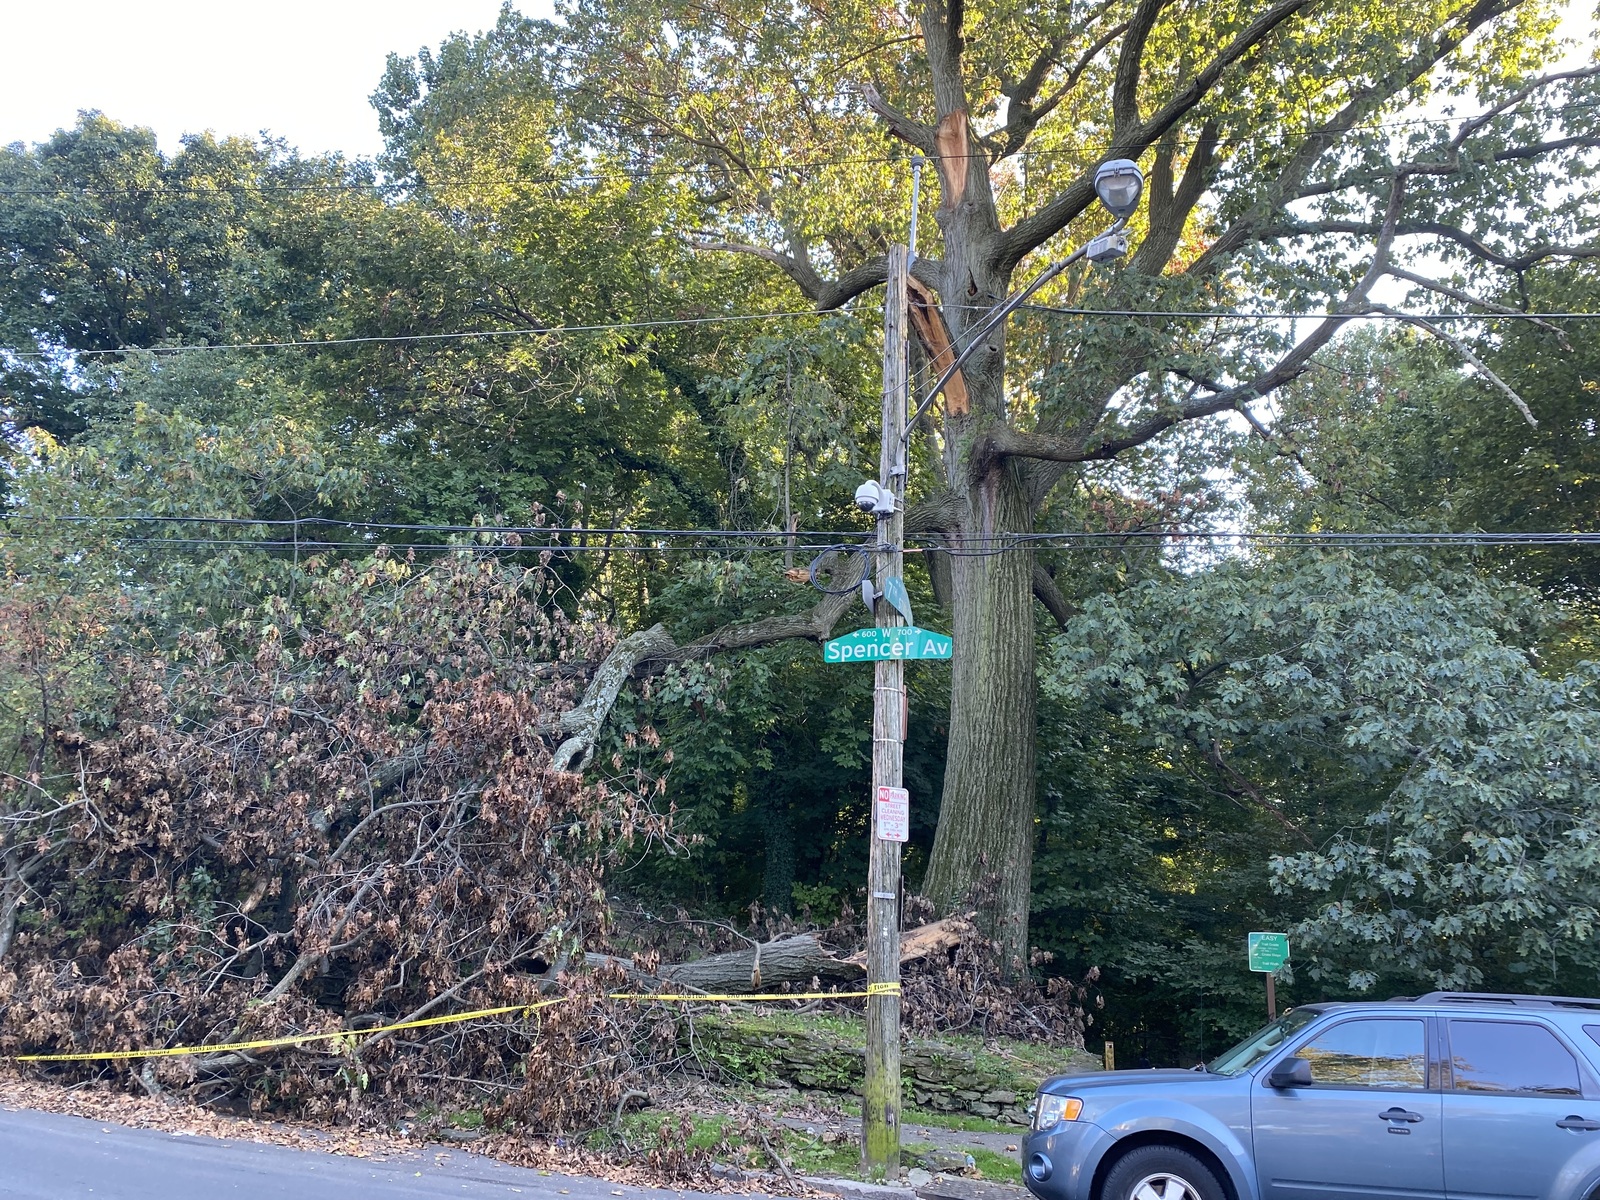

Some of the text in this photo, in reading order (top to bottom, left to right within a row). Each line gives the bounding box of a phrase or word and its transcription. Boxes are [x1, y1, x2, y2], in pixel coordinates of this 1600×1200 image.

[882, 629, 891, 637] W
[828, 639, 948, 662] Spencer Av
[880, 790, 889, 800] NO
